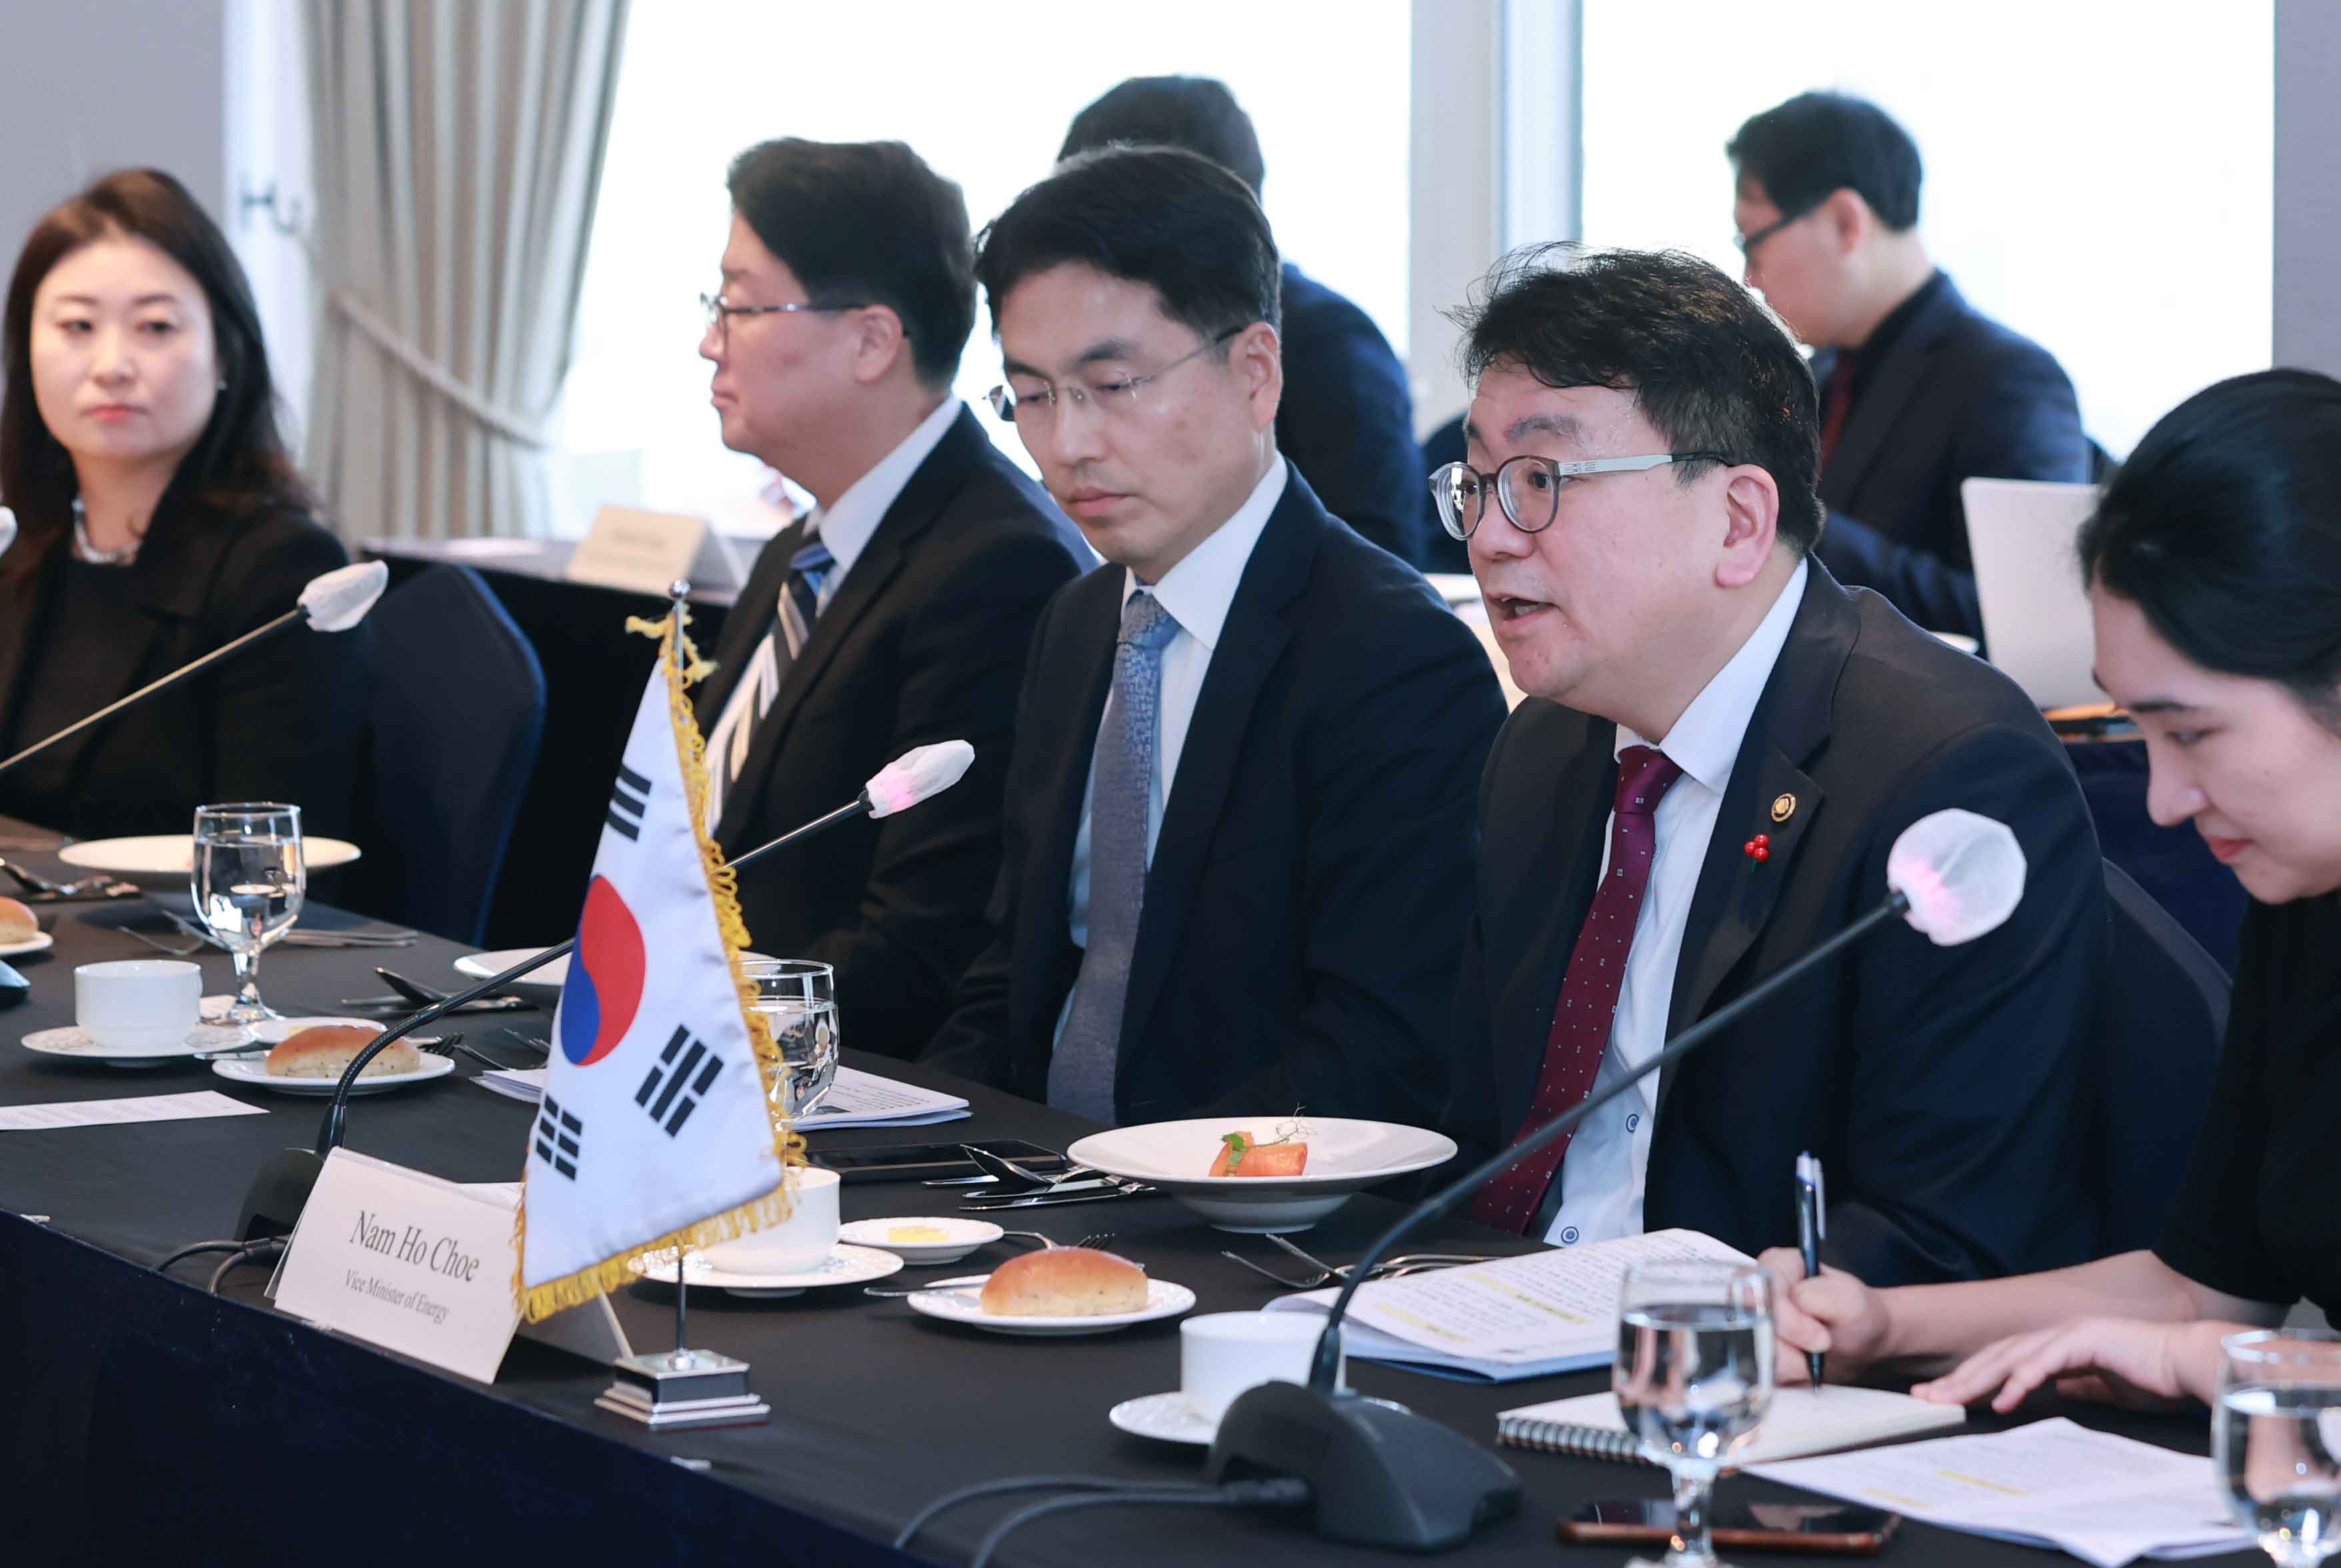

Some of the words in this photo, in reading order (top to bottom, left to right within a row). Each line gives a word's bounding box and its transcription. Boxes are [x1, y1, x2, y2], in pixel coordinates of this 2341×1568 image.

[349, 1210, 396, 1255] Nam
[396, 1225, 427, 1265] Ho
[430, 1237, 479, 1281] Choe
[346, 1268, 366, 1293] Vice
[366, 1276, 405, 1305] Minister
[404, 1291, 420, 1308] of
[415, 1293, 449, 1324] Energy
